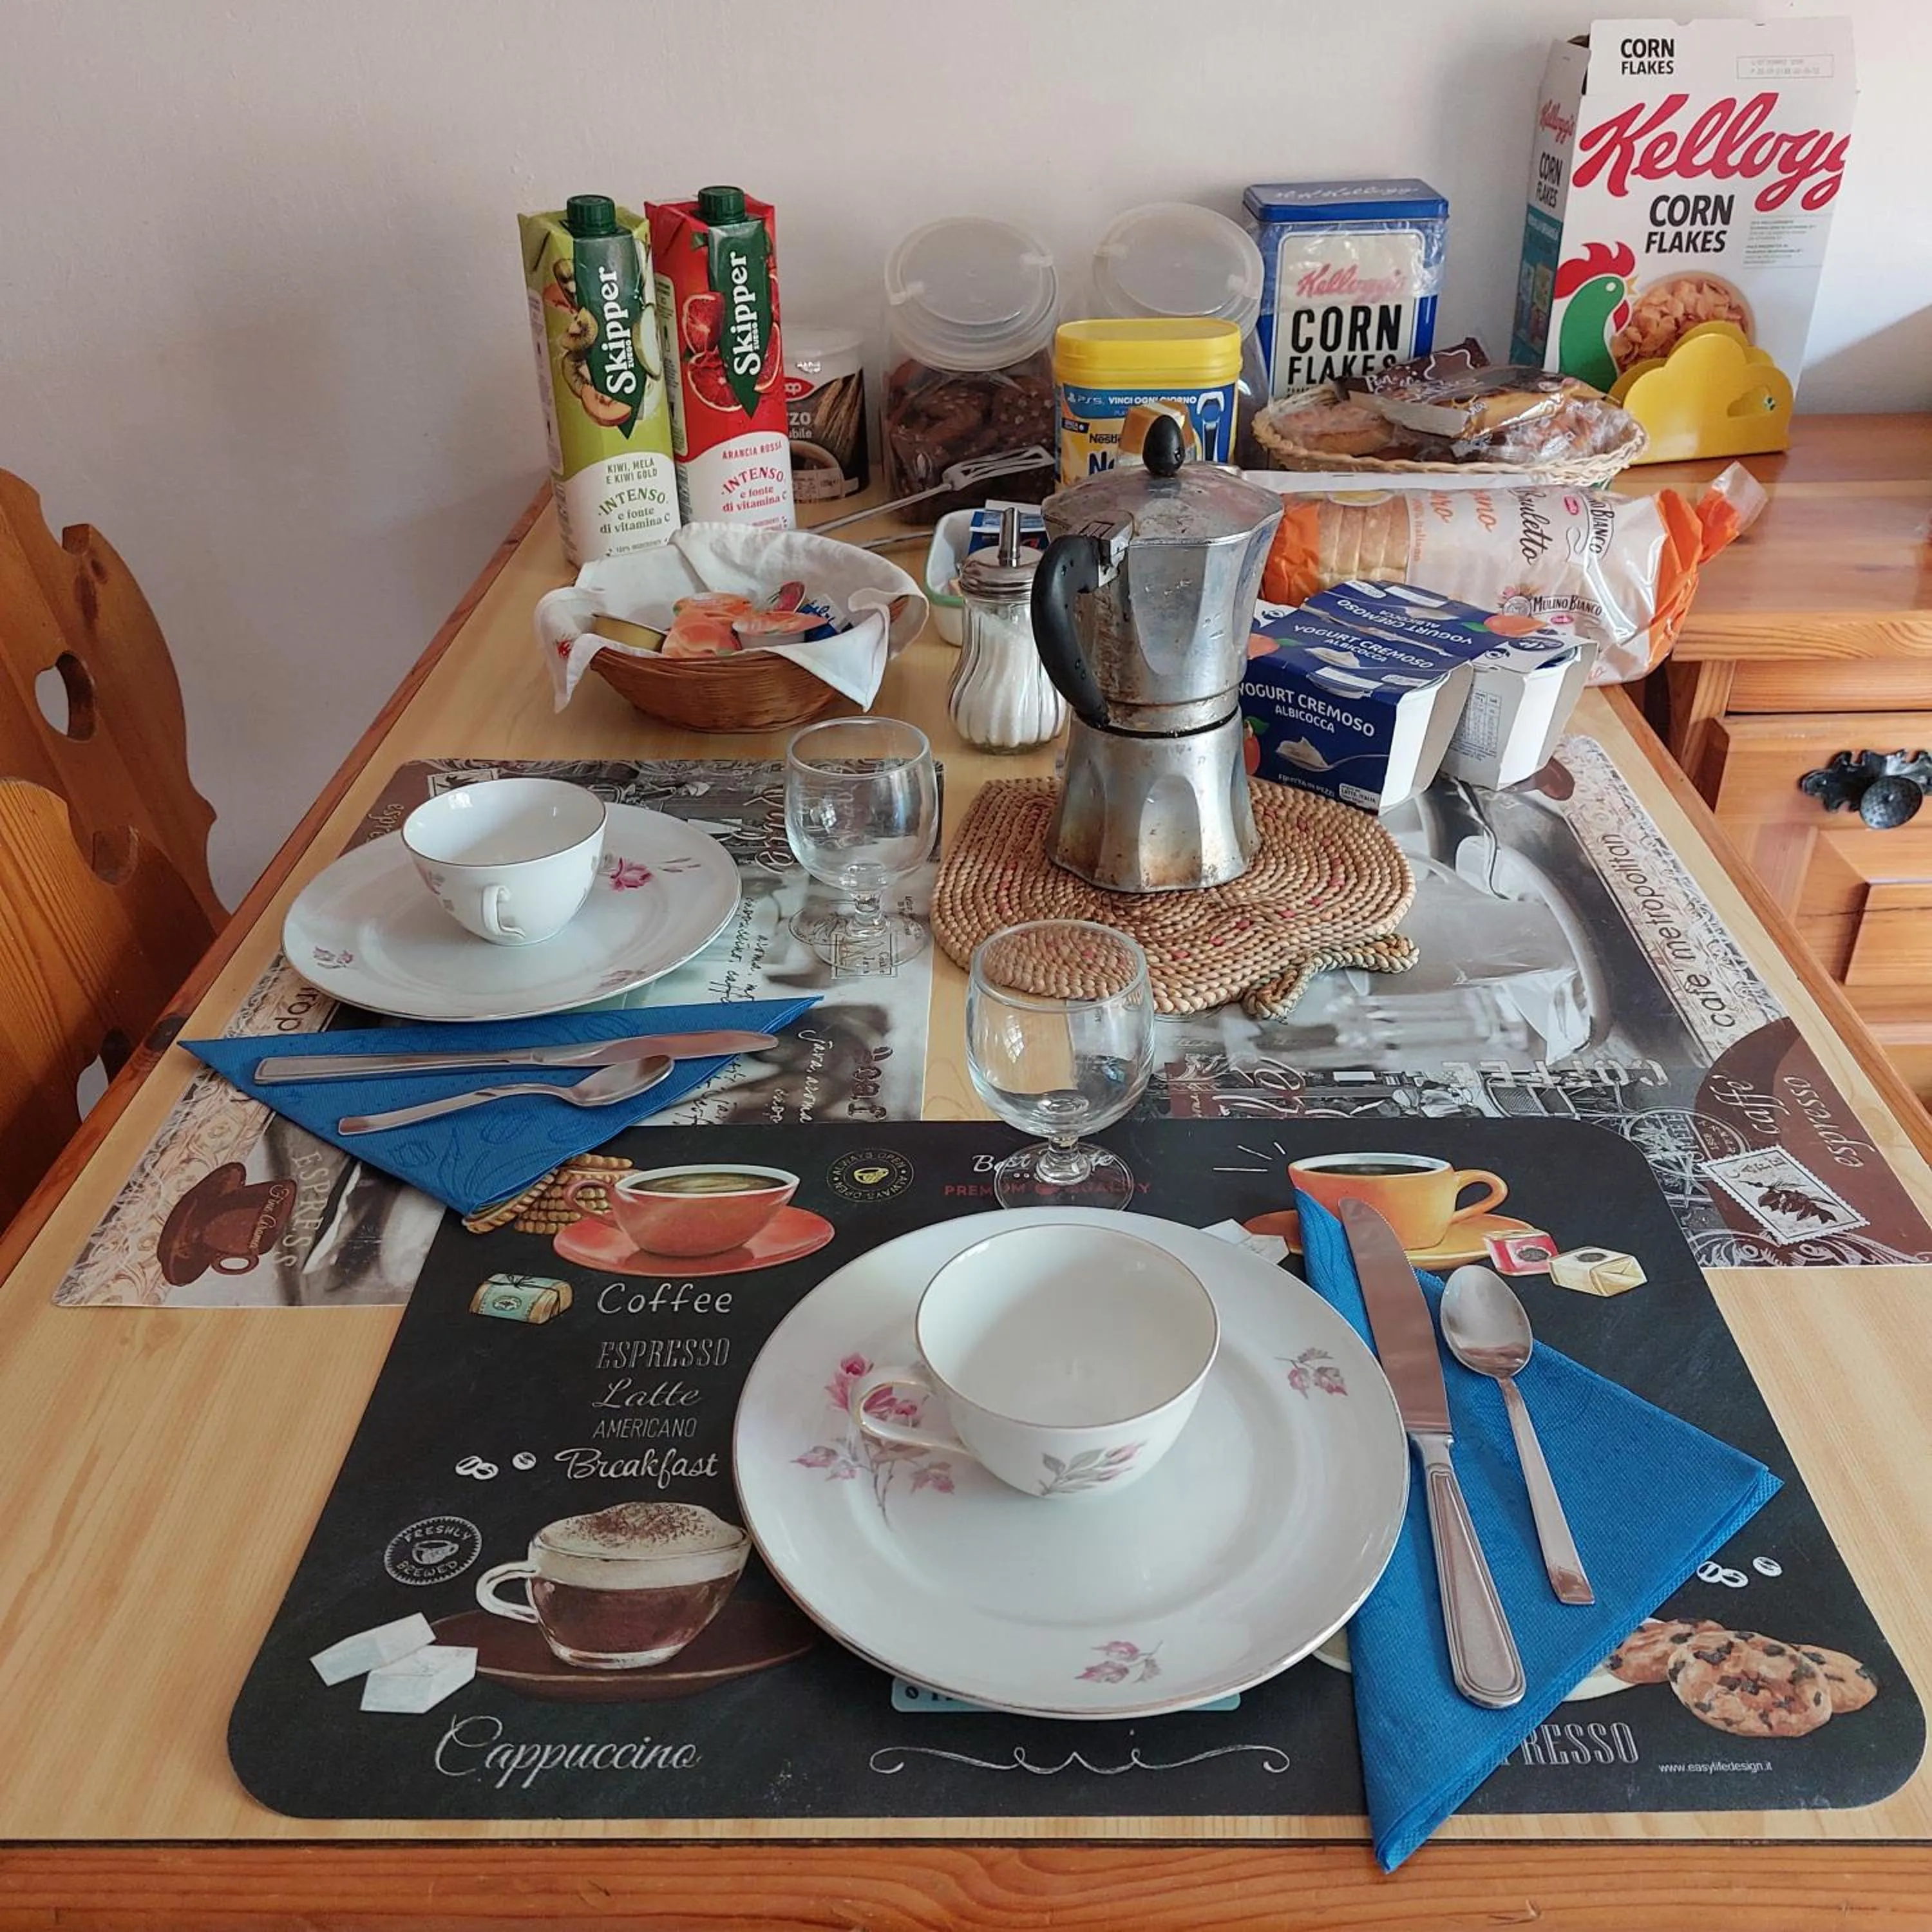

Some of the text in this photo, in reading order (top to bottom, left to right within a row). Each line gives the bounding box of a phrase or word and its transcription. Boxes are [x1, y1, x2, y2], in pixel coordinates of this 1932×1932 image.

[1620, 39, 1675, 58] CORN
[1622, 61, 1674, 75] FLAKES
[1539, 151, 1562, 186] CORN
[1536, 181, 1558, 208] FLAKES
[1649, 194, 1735, 227] CORN
[1645, 231, 1727, 254] FLAKES
[730, 251, 761, 376] Skipper
[599, 266, 637, 394] Skipper
[1291, 304, 1402, 354] CORN
[1108, 396, 1133, 404] VINCI
[633, 458, 655, 469] MELA
[722, 446, 757, 459] ARANCIA
[606, 468, 658, 484] E KIWI GOLD
[723, 500, 734, 512] di
[737, 496, 780, 511] vitamina
[748, 486, 773, 497] fonte
[600, 513, 670, 534] di vitamina C
[627, 507, 654, 519] fonte
[1532, 594, 1602, 616] MULINO BIANCO
[1337, 600, 1473, 645] YOGURT CREMOSO
[1293, 625, 1434, 668] YOGURT CREMOSO
[1325, 639, 1387, 662] ALBICOCCA
[1239, 683, 1375, 737] YOGURT CREMOSO
[1275, 705, 1335, 733] ALBICOCCA
[1602, 833, 1696, 961] metropolitan
[1783, 1075, 1877, 1169] espresso
[597, 1282, 733, 1314] Coffee
[596, 1338, 730, 1369] ESPRESSO
[592, 1378, 703, 1408] Latte
[592, 1417, 697, 1439] AMERICANO
[554, 1448, 719, 1490] Breakfast
[404, 1525, 472, 1543] FRESHLY
[396, 1560, 458, 1578] BREWED
[435, 1714, 701, 1788] Cappuccino
[1502, 1722, 1639, 1766] RESSO
[1658, 1760, 1773, 1774] www.easylifedesign.it
